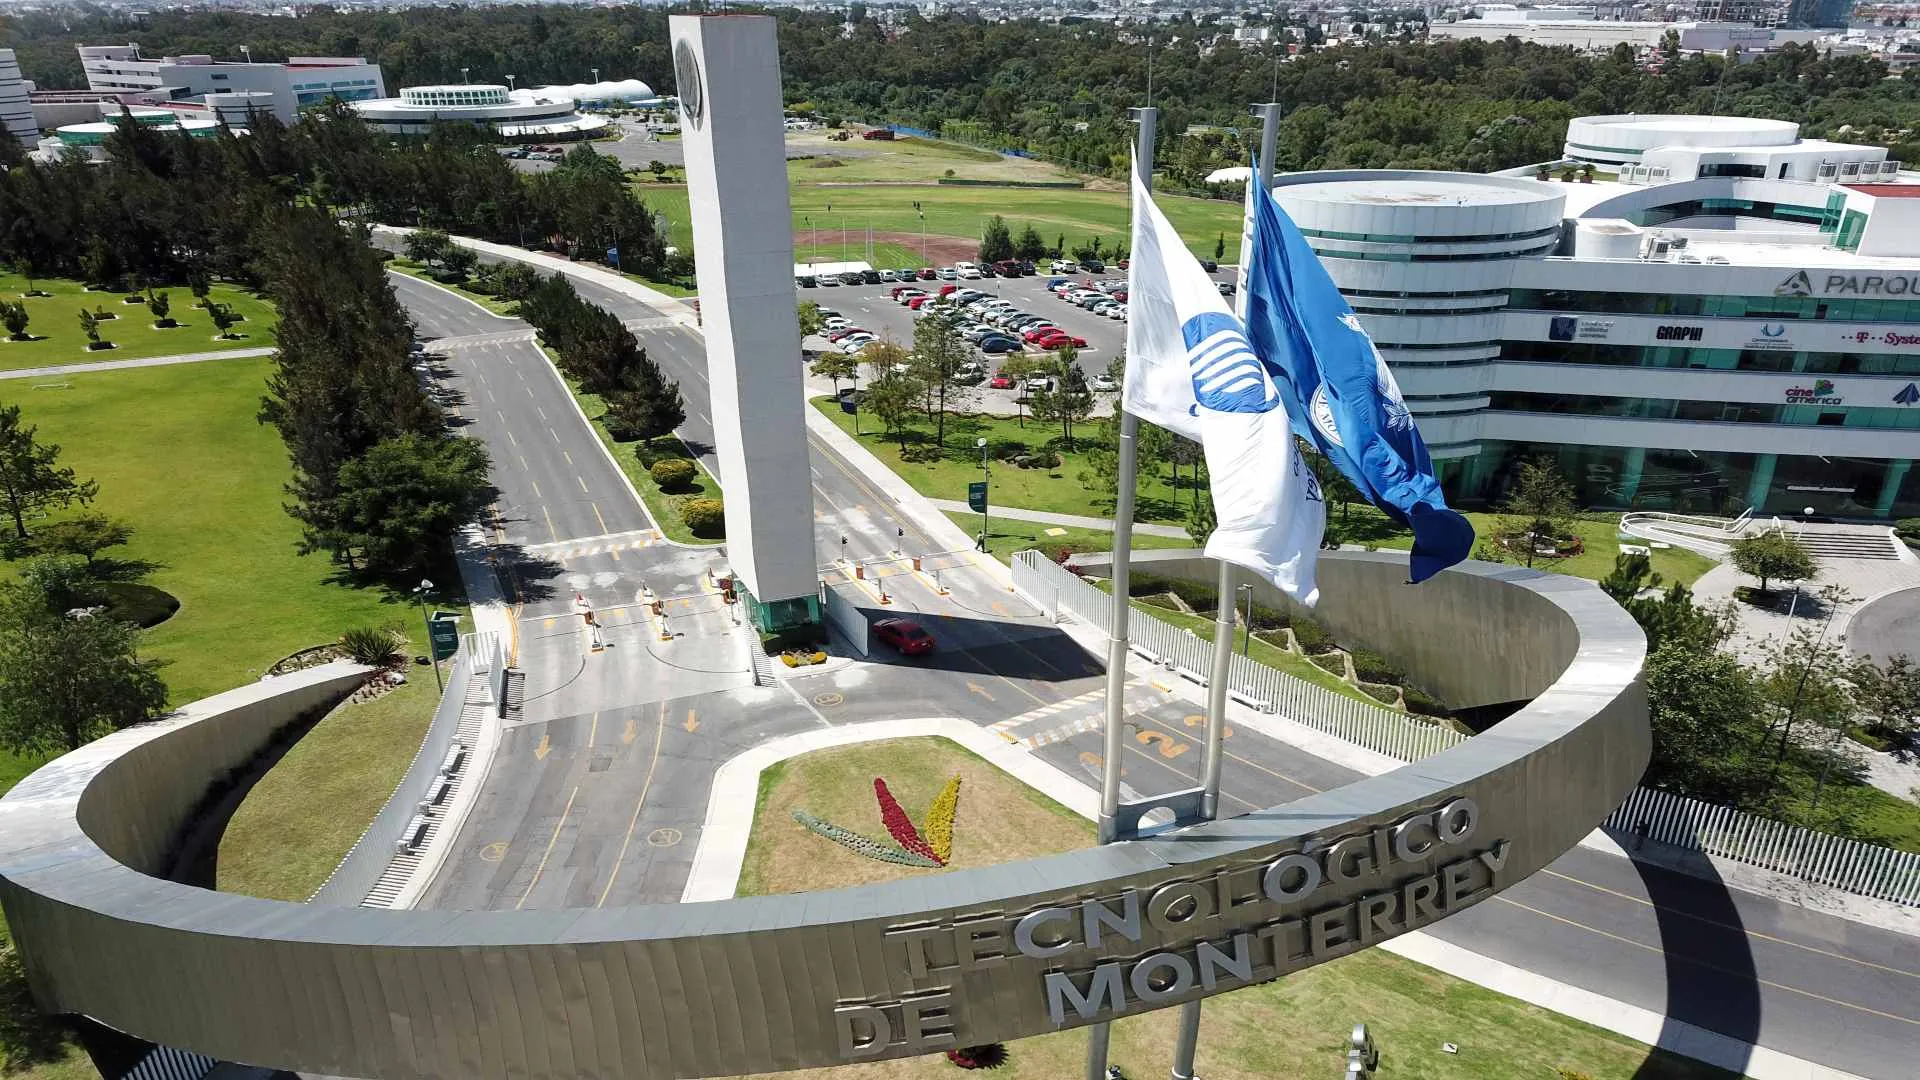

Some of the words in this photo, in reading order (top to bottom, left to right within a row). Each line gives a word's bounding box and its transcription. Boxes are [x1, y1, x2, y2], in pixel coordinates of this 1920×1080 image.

[1785, 385, 1813, 397] cine
[834, 989, 957, 1059] DE
[1045, 840, 1513, 1026] MONTERREY
[884, 797, 1479, 980] TECNOLÓGICO
